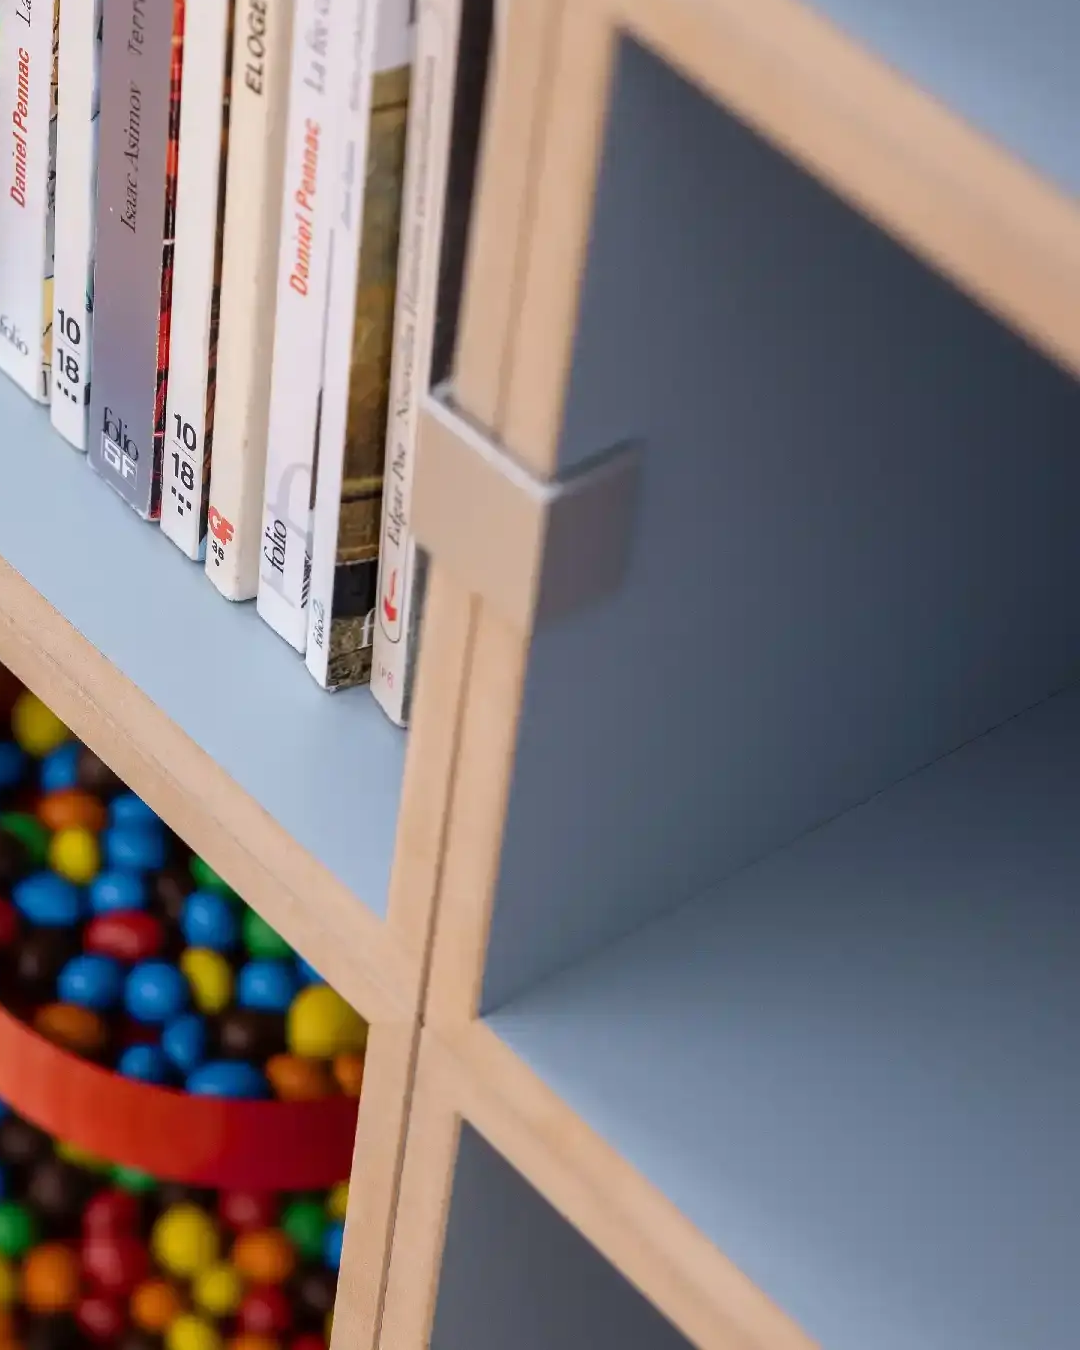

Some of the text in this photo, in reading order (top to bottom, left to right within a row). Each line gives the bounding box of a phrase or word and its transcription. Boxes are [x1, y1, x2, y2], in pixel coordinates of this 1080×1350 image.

[13, 47, 30, 135] Pennac
[123, 82, 143, 172] Asimov
[10, 131, 28, 209] Daniel
[295, 118, 321, 212] Pennac
[120, 171, 139, 234] Isaac
[289, 212, 313, 296] Daniel
[57, 308, 81, 345] 10
[57, 348, 80, 384] 18
[103, 407, 139, 461] folio
[174, 412, 197, 451] 10
[172, 452, 194, 490] 18
[208, 506, 234, 545] GF
[263, 519, 287, 574] folio
